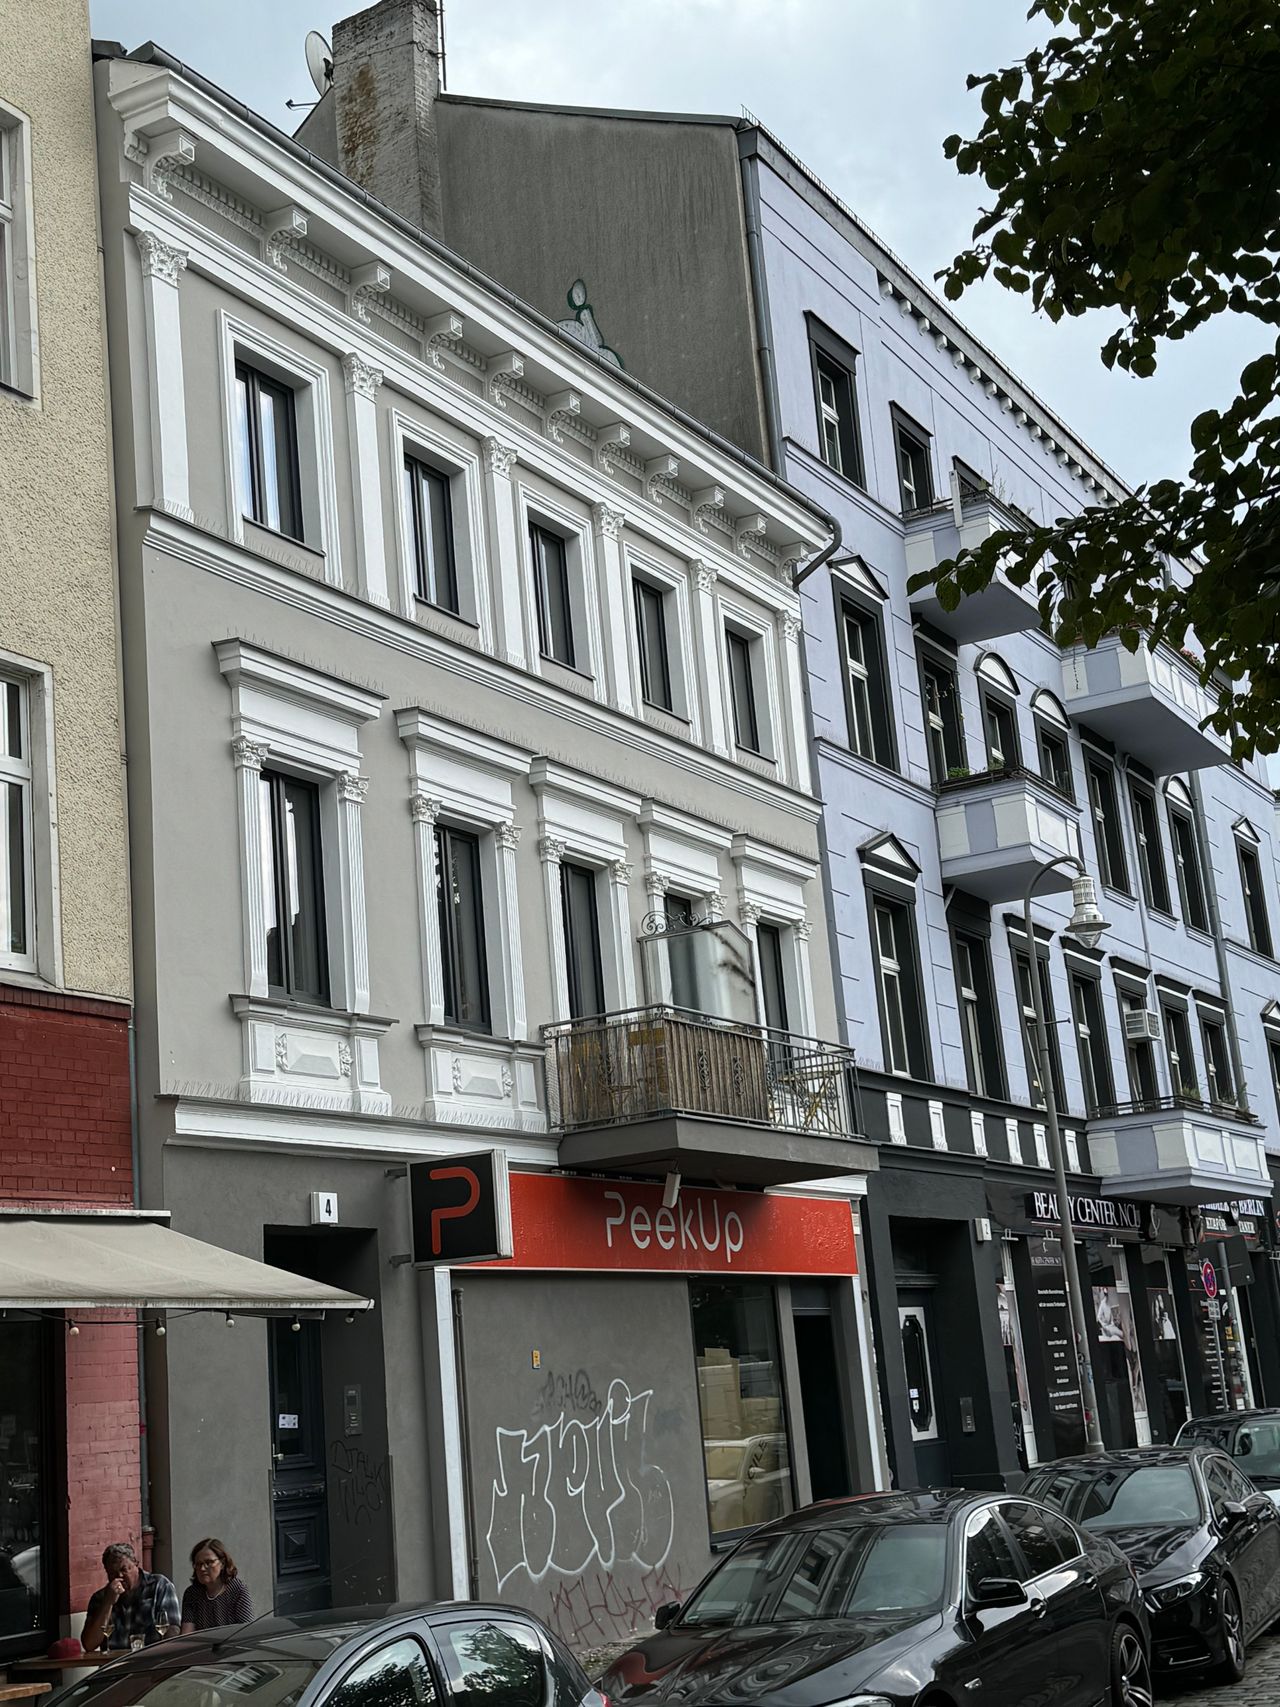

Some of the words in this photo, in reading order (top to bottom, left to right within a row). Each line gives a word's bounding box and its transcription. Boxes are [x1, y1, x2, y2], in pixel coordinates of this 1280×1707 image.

[325, 1198, 332, 1217] 4
[429, 1166, 480, 1254] P
[604, 1191, 744, 1263] PeekUp
[1076, 1197, 1119, 1226] CENTER
